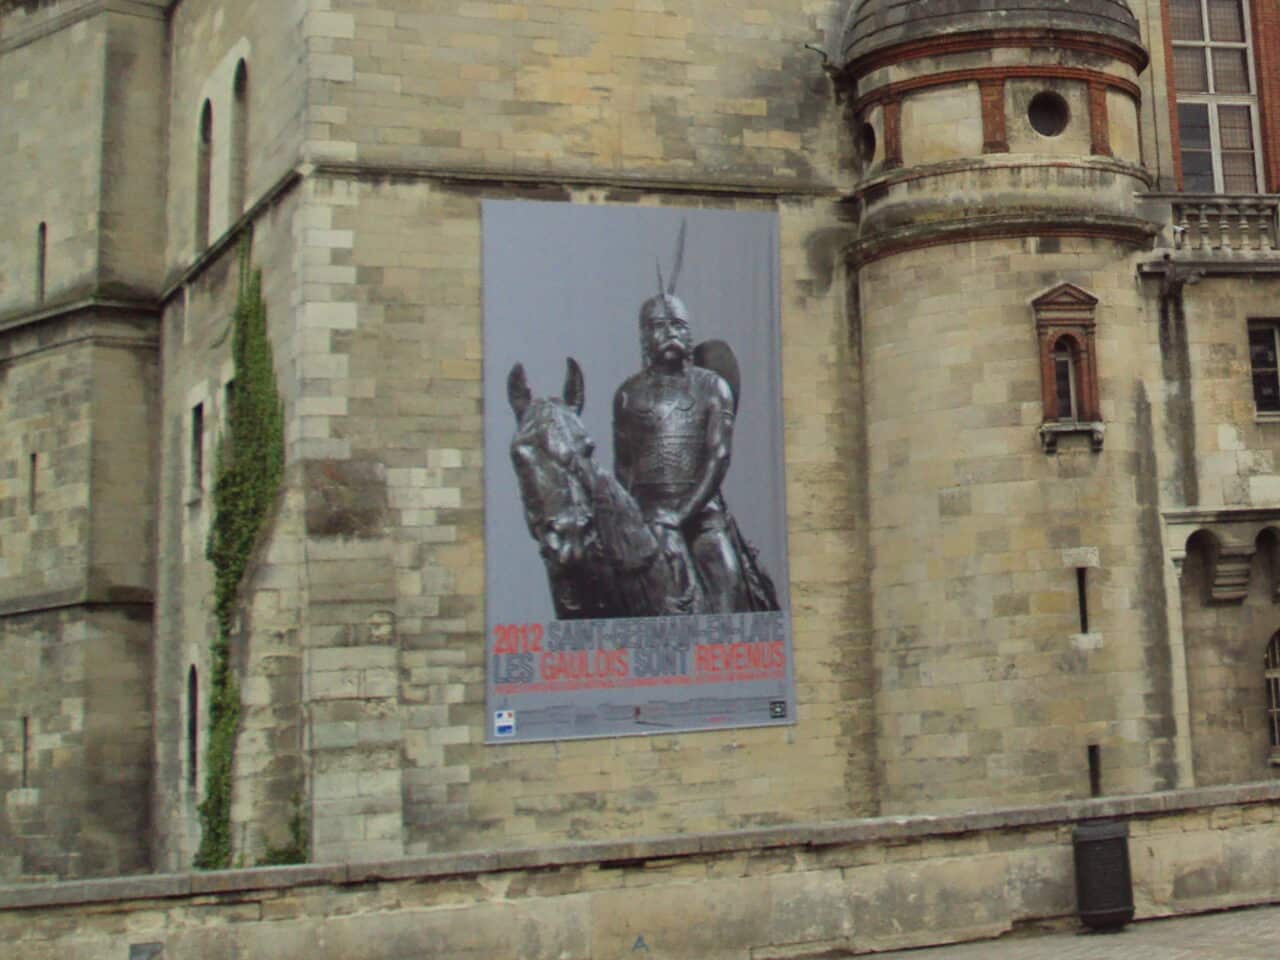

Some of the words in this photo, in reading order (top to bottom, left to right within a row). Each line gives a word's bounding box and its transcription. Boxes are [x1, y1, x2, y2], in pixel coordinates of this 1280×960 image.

[493, 623, 543, 655] 2012
[494, 652, 534, 684] LES
[539, 648, 629, 681] GAULOIS
[634, 645, 688, 677] SONT
[693, 640, 785, 672] REVENUS
